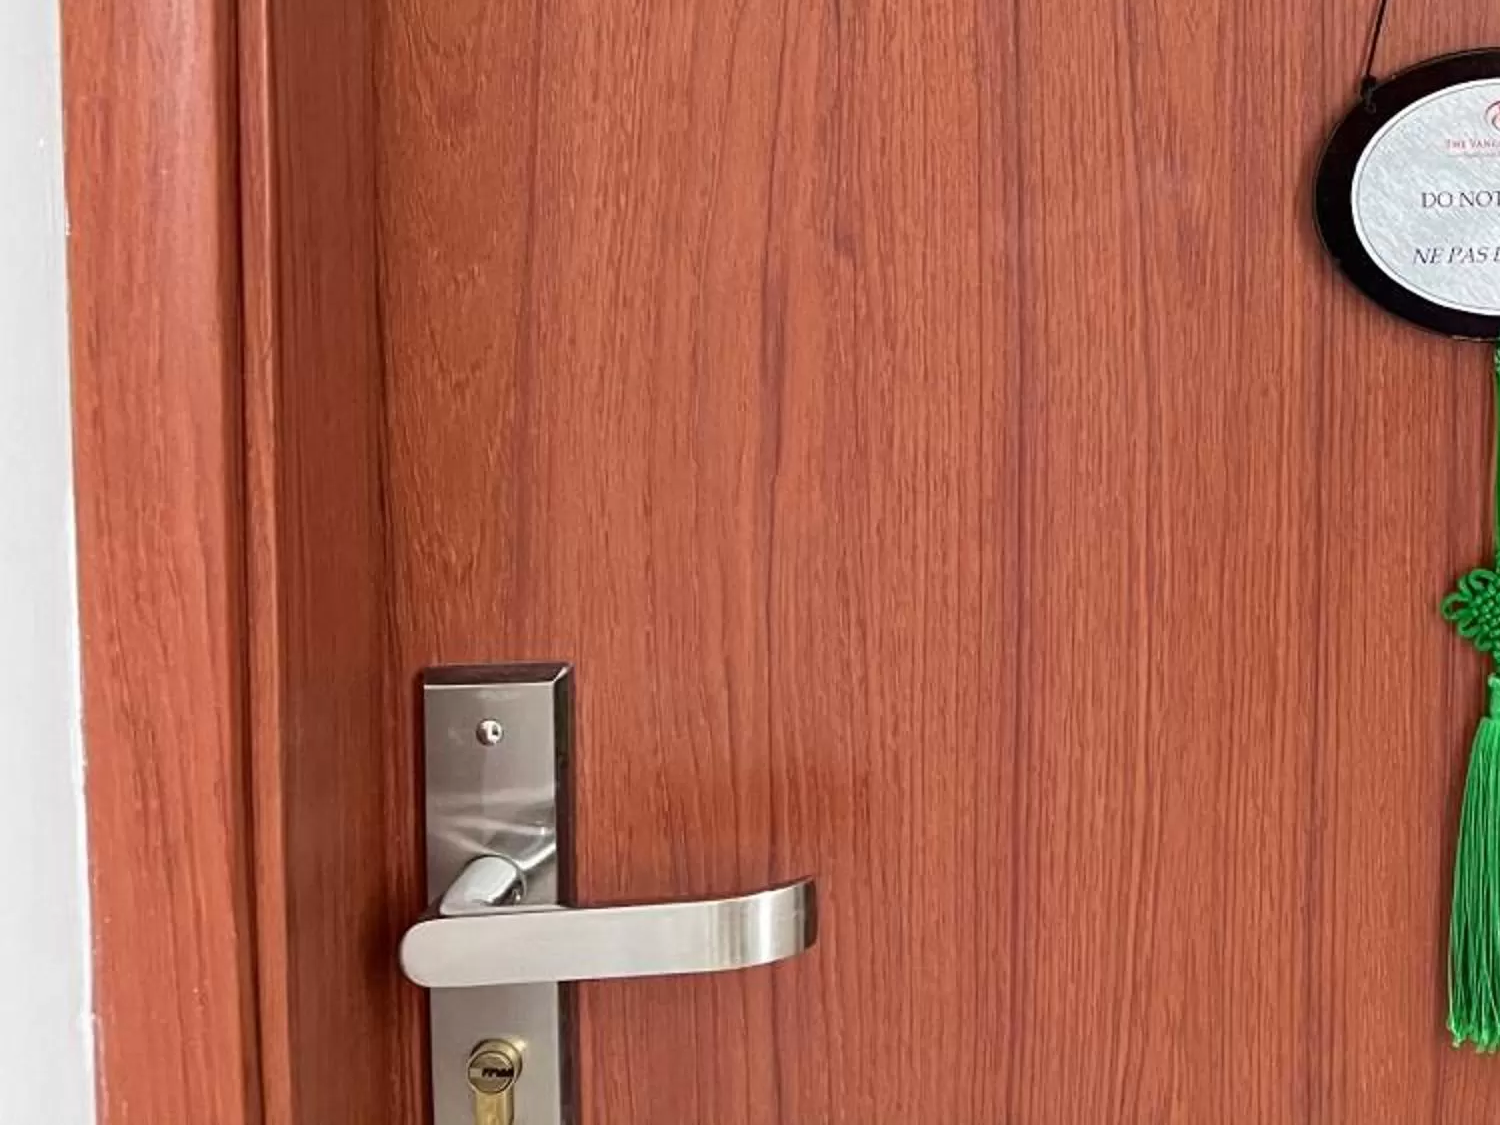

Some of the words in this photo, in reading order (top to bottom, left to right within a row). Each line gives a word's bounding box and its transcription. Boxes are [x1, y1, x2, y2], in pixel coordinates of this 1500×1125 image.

[1446, 139, 1467, 149] THE
[1421, 190, 1453, 208] DO
[1412, 246, 1444, 265] NE
[1449, 245, 1489, 264] PAS
